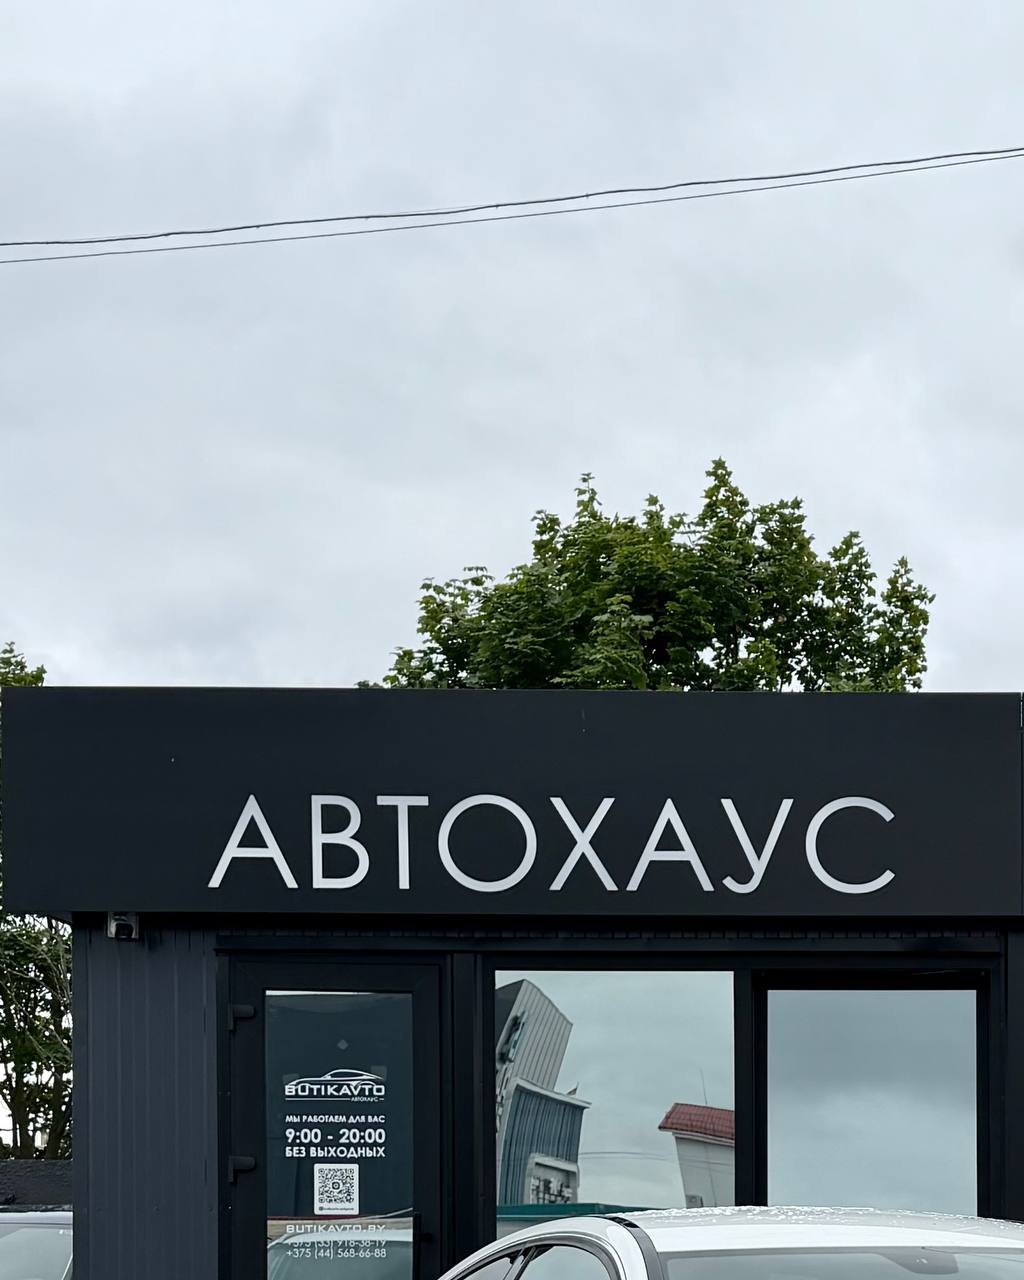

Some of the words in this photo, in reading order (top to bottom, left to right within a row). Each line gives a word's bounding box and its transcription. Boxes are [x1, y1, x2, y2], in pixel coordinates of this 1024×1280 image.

[207, 794, 896, 895] АВТОХАУС
[285, 1084, 386, 1096] BUTIKAVTO
[285, 1115, 301, 1123] МЫ
[302, 1115, 347, 1123] РАБОТАЕМ
[347, 1115, 366, 1124] ДЛЯ
[367, 1115, 386, 1123] ВАС
[285, 1128, 321, 1144] 9:00
[339, 1128, 386, 1144] 20:00
[285, 1146, 306, 1158] БЕЗ
[309, 1146, 386, 1159] ВЫХОДНЫХ
[286, 1224, 386, 1234] BUTIKAVTO.BY
[286, 1248, 312, 1258] +375
[314, 1248, 334, 1260] (44)
[337, 1248, 387, 1258] 568-66-88
